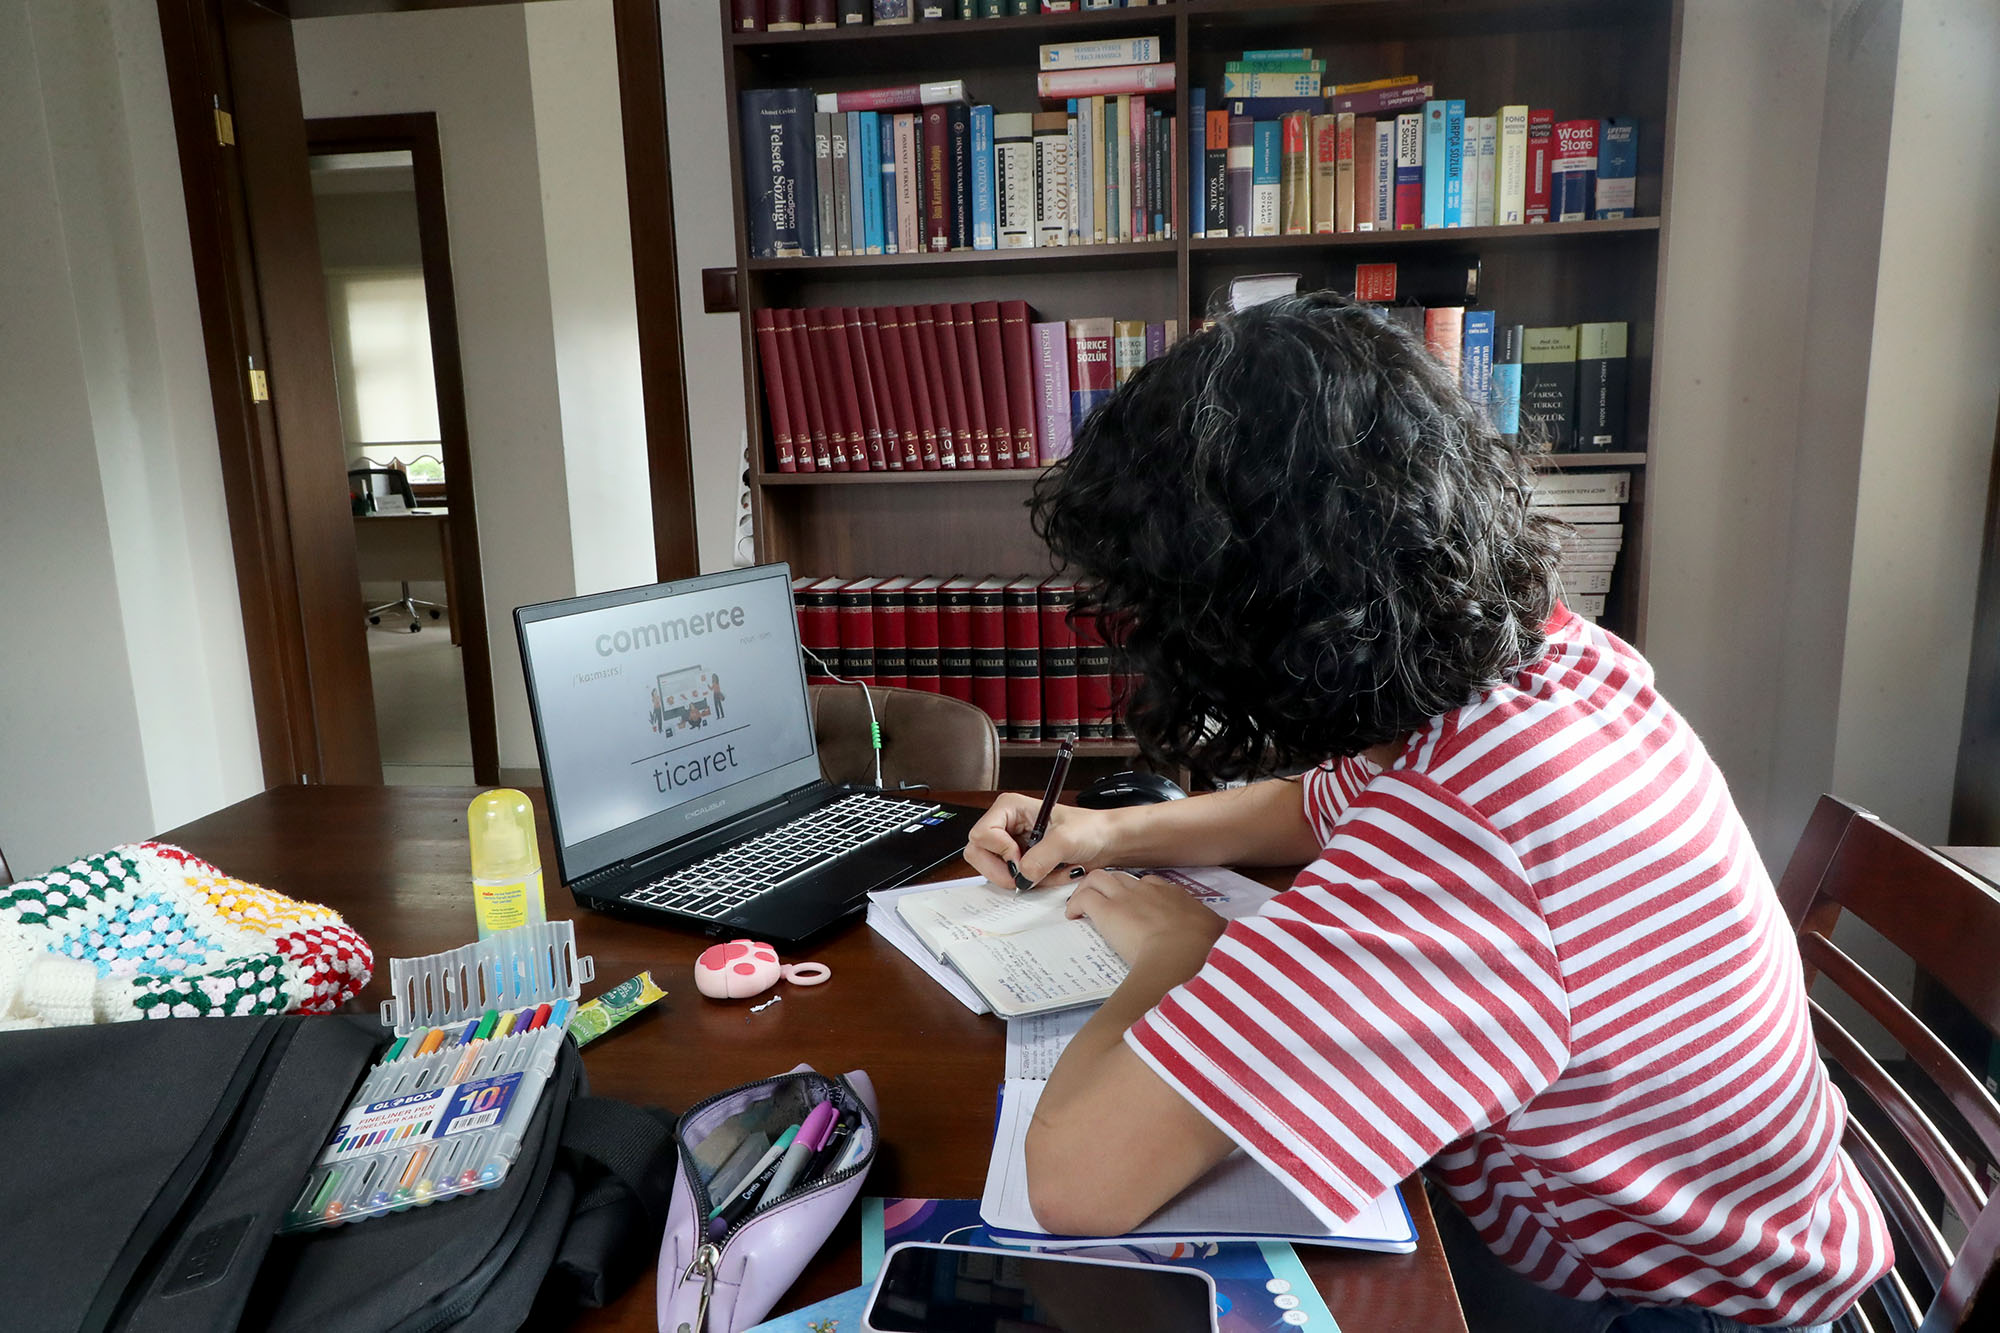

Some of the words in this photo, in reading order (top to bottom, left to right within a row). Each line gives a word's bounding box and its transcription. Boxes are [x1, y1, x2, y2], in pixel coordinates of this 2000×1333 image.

[1505, 115, 1526, 123] FONO
[1449, 117, 1461, 147] SIRPÇA
[1558, 126, 1593, 141] Word
[770, 124, 786, 173] Felsefe
[1380, 133, 1389, 158] SÖZLÜK
[1401, 127, 1410, 159] Sözlük
[1409, 119, 1419, 166] Fransızca
[1560, 139, 1593, 152] Store
[1449, 148, 1461, 178] SÖZLÜK
[957, 155, 965, 205] KAVRAMLAR
[1007, 146, 1015, 226] PSİKOLOJİ
[1053, 142, 1068, 220] SÖZLÜĞÜ
[1210, 177, 1218, 212] SÖZLÜK
[771, 174, 787, 231] Sözlüğü
[786, 179, 796, 230] Paradigma
[1218, 195, 1226, 225] FARSÇA
[1042, 328, 1050, 368] RESİMLİ
[1076, 340, 1108, 351] TÜRKÇE
[1473, 345, 1480, 355] VE
[1077, 351, 1108, 363] SÖZLÜK
[1045, 372, 1054, 410] TÜRKÇE
[1528, 412, 1566, 422] SÖZLÜK
[800, 447, 808, 457] 2
[819, 443, 826, 454] 3
[836, 445, 842, 456] 4
[852, 445, 860, 456] 5
[871, 441, 879, 452] 6
[888, 440, 896, 452] 7
[906, 443, 915, 456] 8
[924, 443, 934, 455] 9
[1018, 441, 1031, 452] 14
[818, 596, 824, 604] 2
[918, 596, 924, 604] 5
[595, 605, 745, 658] commerce
[844, 659, 873, 667] TÜRKLER
[909, 659, 938, 667] TÜRKLER
[943, 658, 971, 666] TÜRKLER
[975, 658, 1004, 667] TÜRKLER
[1009, 658, 1038, 667] TÜRKLER
[653, 744, 739, 794] ticaret
[459, 1086, 500, 1114] 10
[359, 1107, 412, 1125] FINELINER
[413, 1103, 436, 1115] PEN
[354, 1115, 400, 1133] FINELINER
[400, 1110, 433, 1123] KALEM
